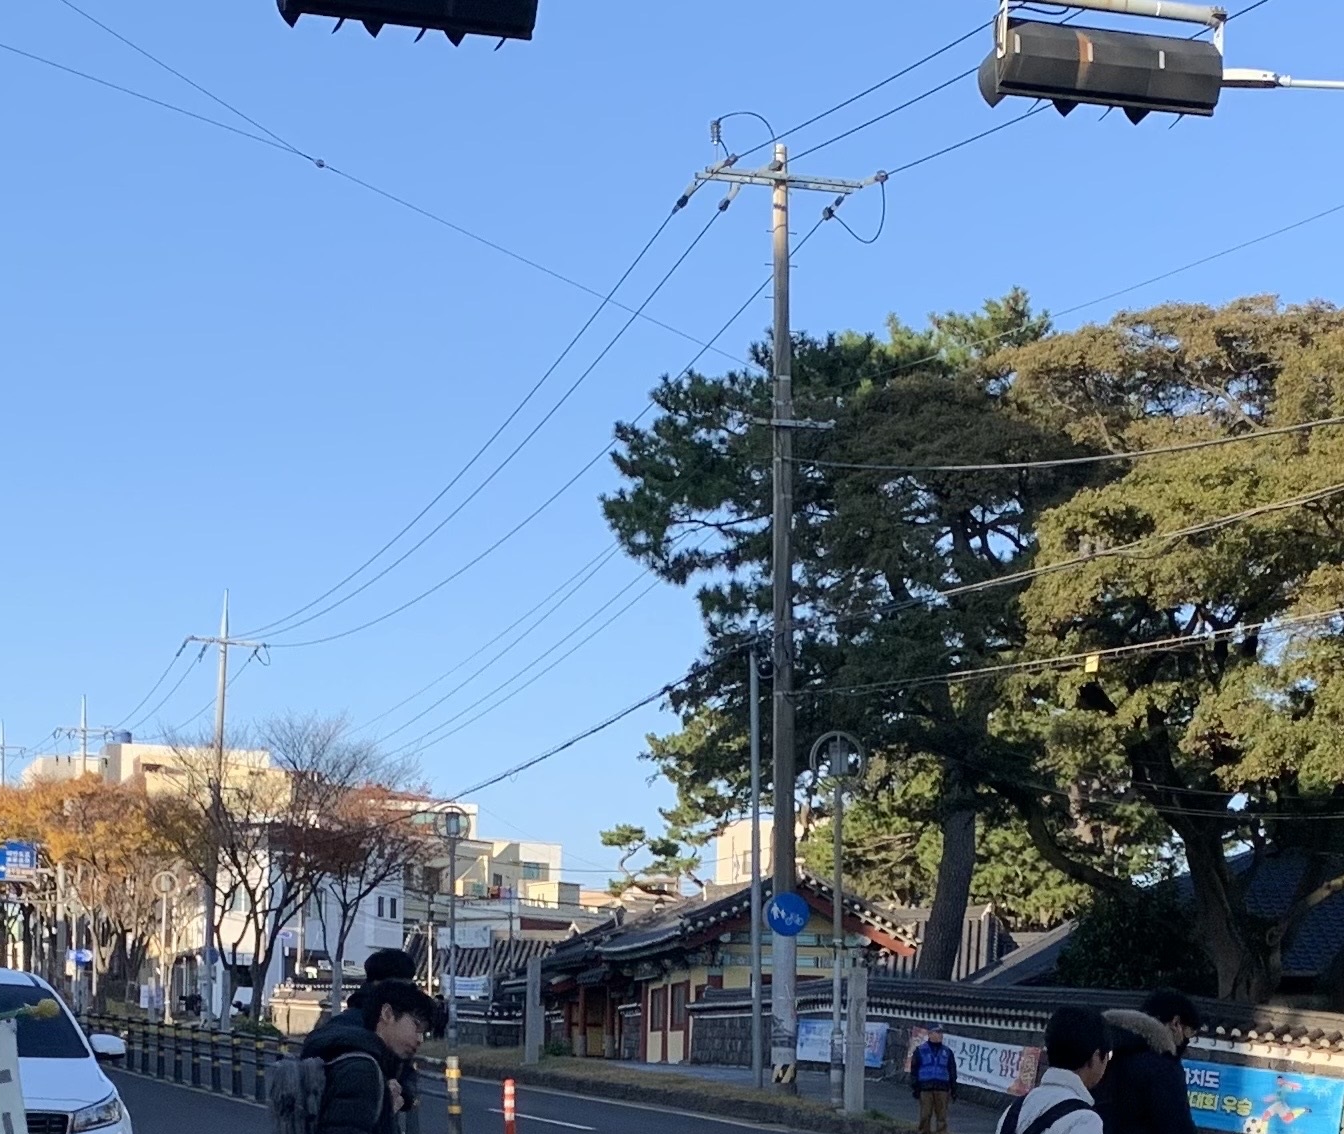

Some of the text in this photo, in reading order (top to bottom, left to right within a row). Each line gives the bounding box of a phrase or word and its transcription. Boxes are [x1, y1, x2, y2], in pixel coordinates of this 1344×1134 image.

[956, 1041, 998, 1074] 수원FC
[1187, 1091, 1253, 1117] 대회 우승
